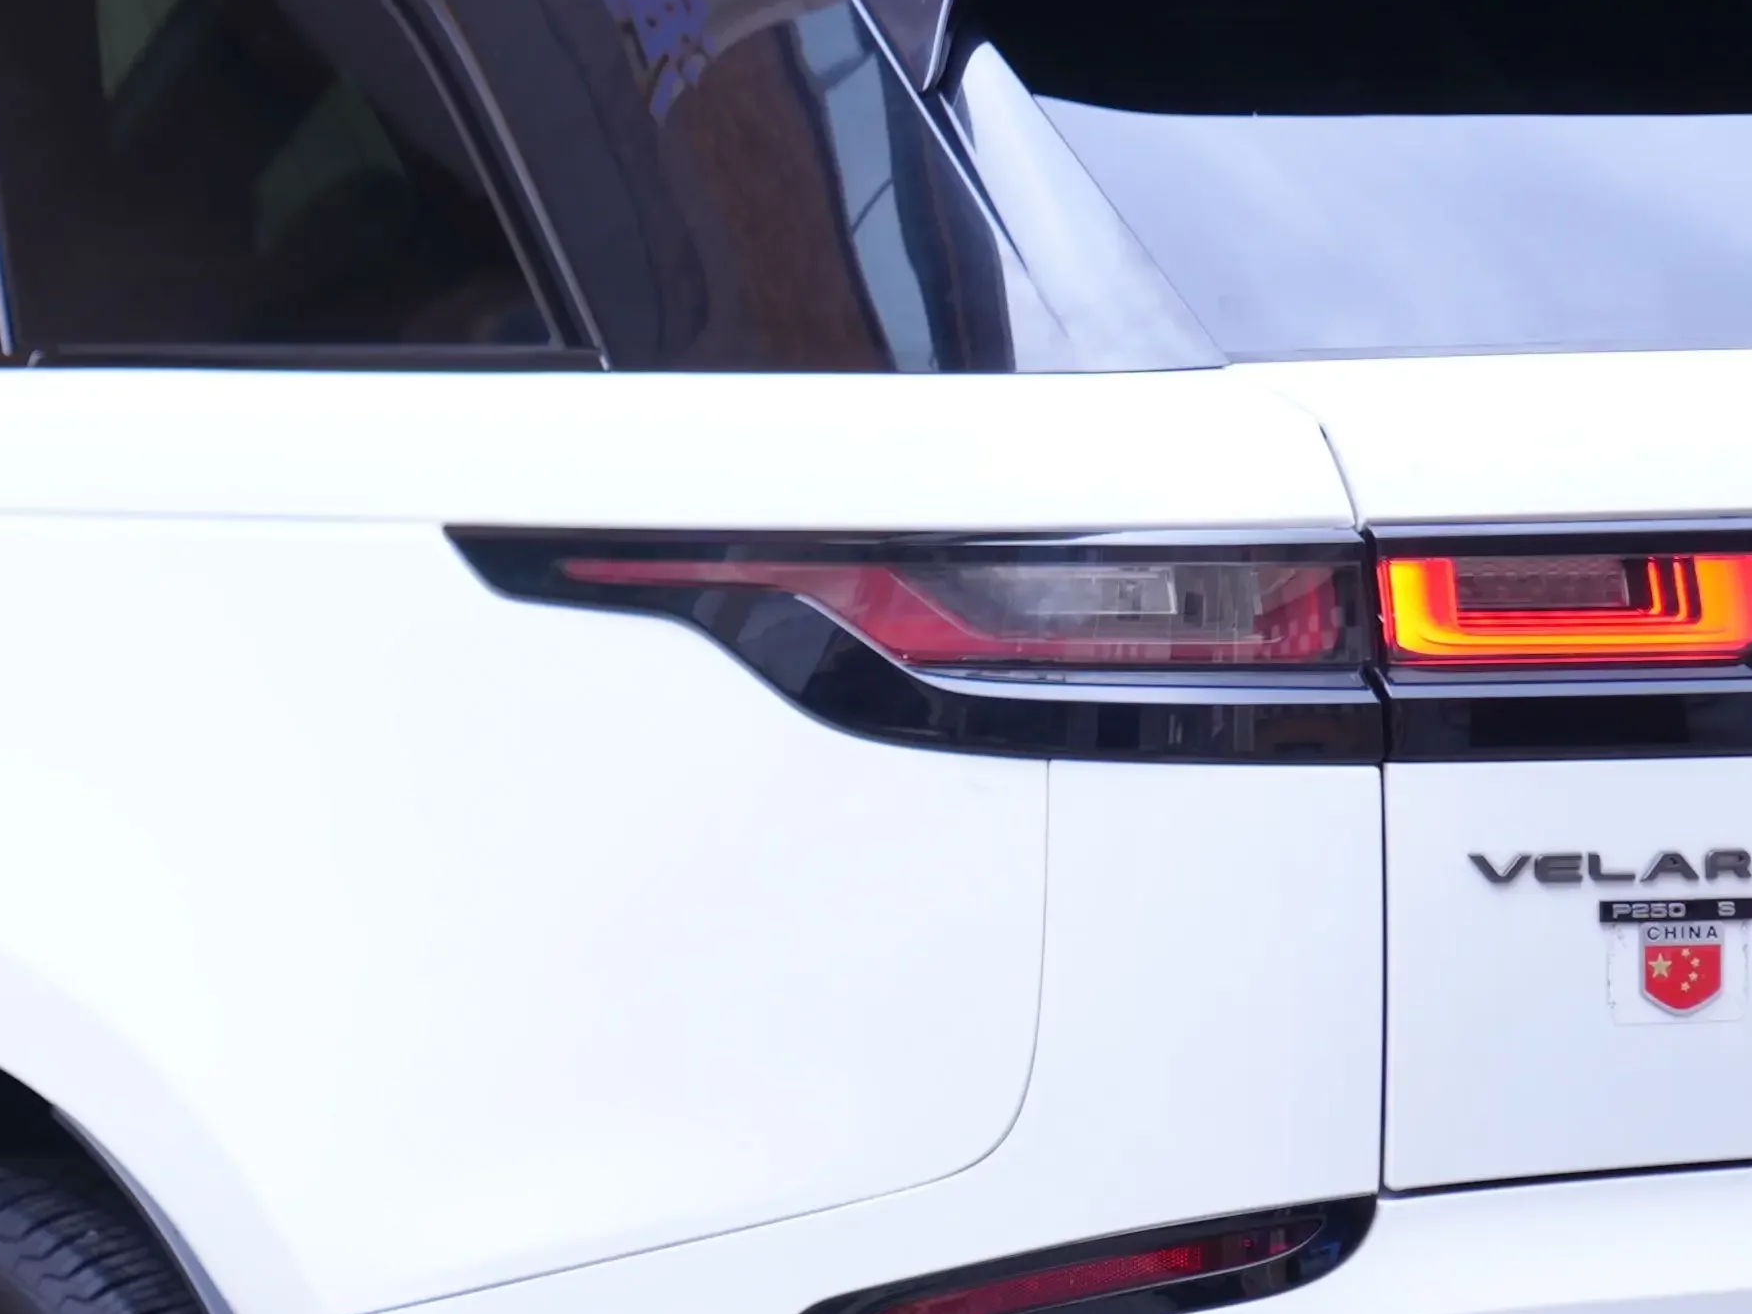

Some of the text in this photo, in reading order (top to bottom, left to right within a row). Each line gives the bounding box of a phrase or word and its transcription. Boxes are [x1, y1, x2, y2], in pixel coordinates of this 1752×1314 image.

[1467, 848, 1752, 884] VELAR
[1611, 900, 1736, 919] P250 S
[1646, 925, 1719, 941] CHINA
